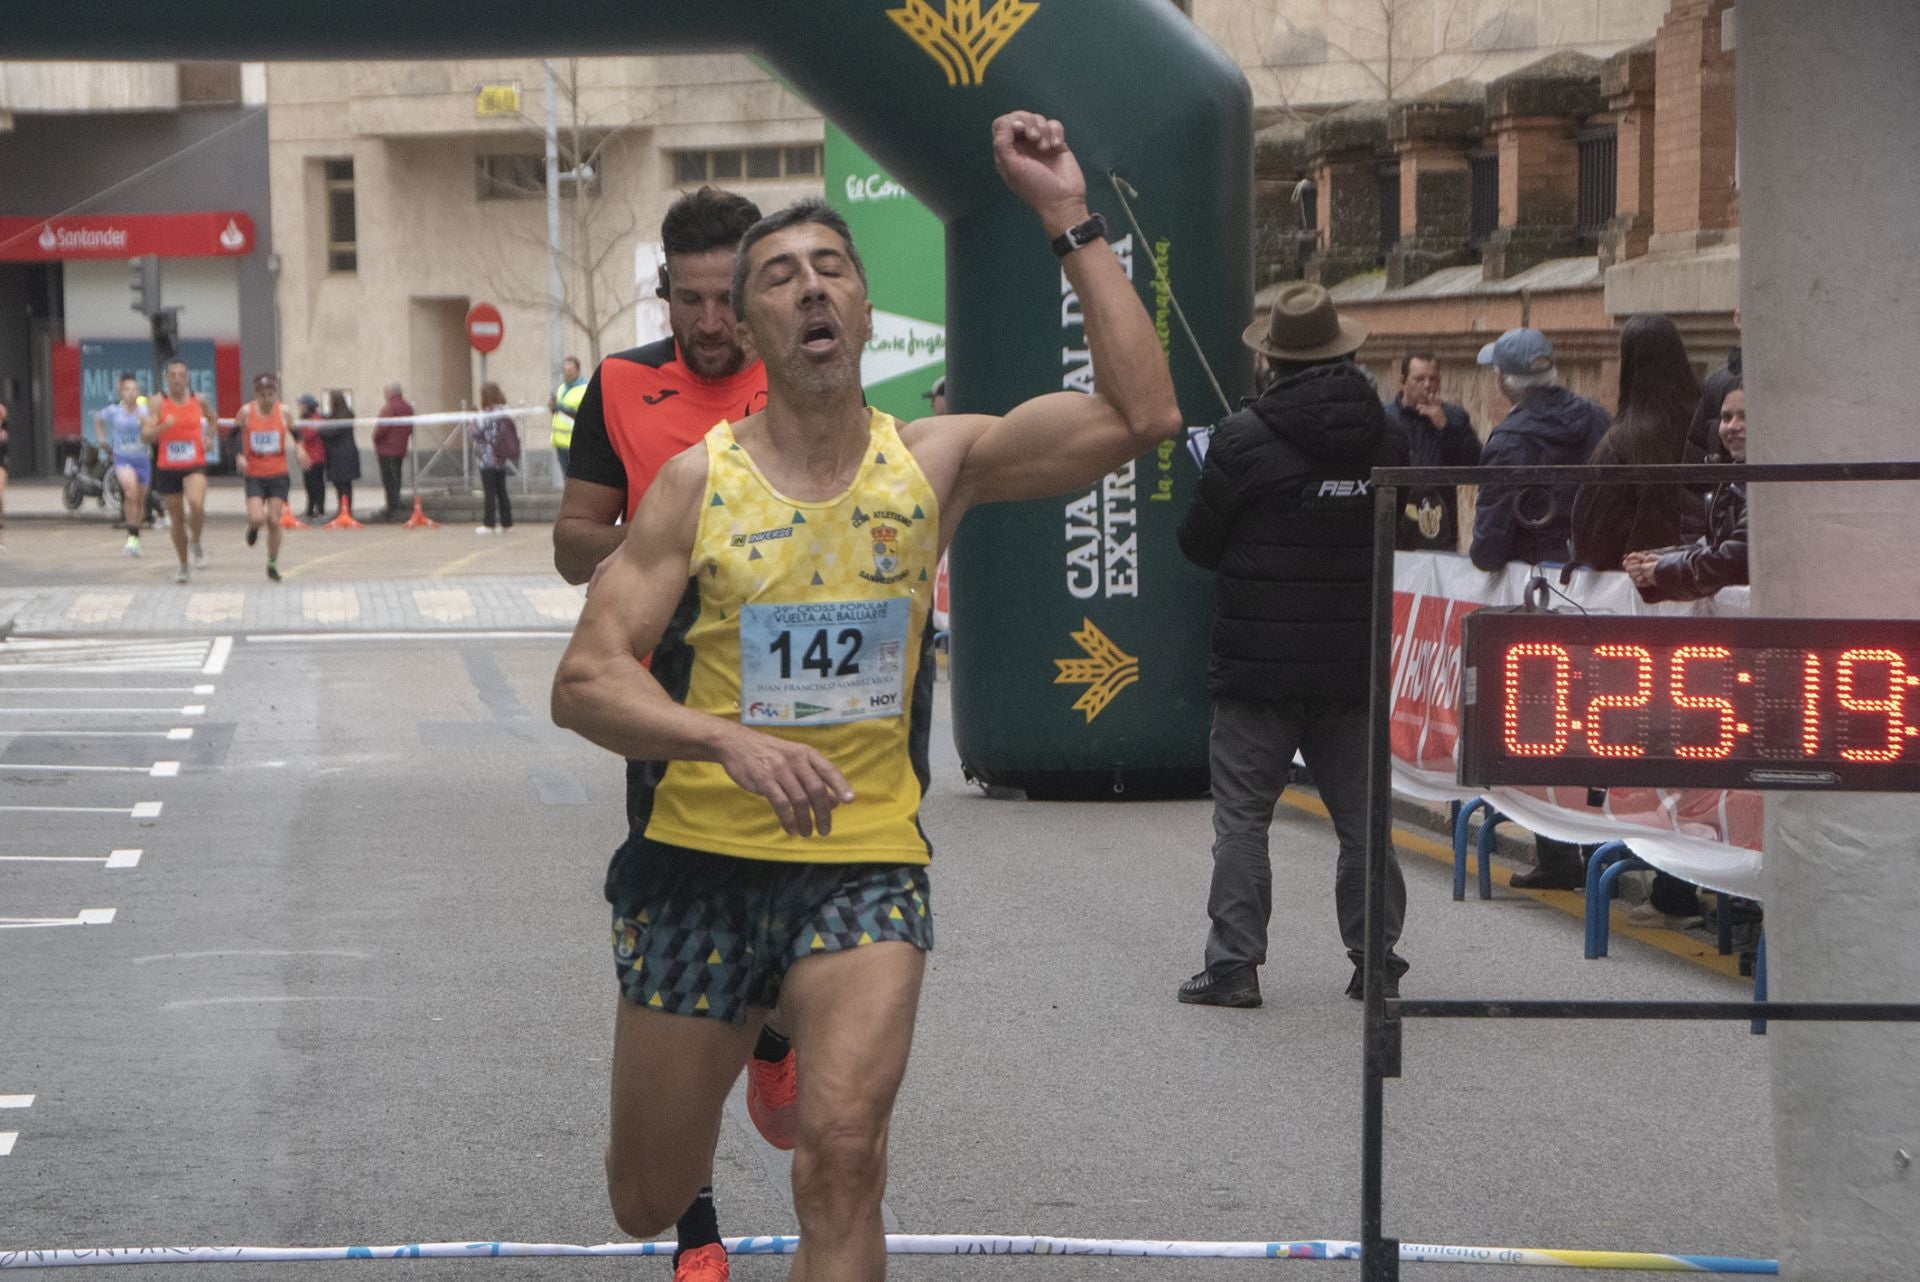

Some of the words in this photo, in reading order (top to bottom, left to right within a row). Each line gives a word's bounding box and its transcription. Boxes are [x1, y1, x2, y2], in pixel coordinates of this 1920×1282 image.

[57, 227, 127, 248] Santander
[747, 527, 794, 544] INVERSE
[1065, 490, 1102, 599] CAJA
[796, 603, 837, 614] CROSS
[839, 601, 889, 612] POPULAR
[774, 613, 817, 625] VUELTA
[818, 612, 833, 623] AL
[836, 609, 888, 622] BALUARTE
[769, 627, 864, 679] 142
[870, 692, 898, 708] HOY
[1499, 1249, 1523, 1264] de
